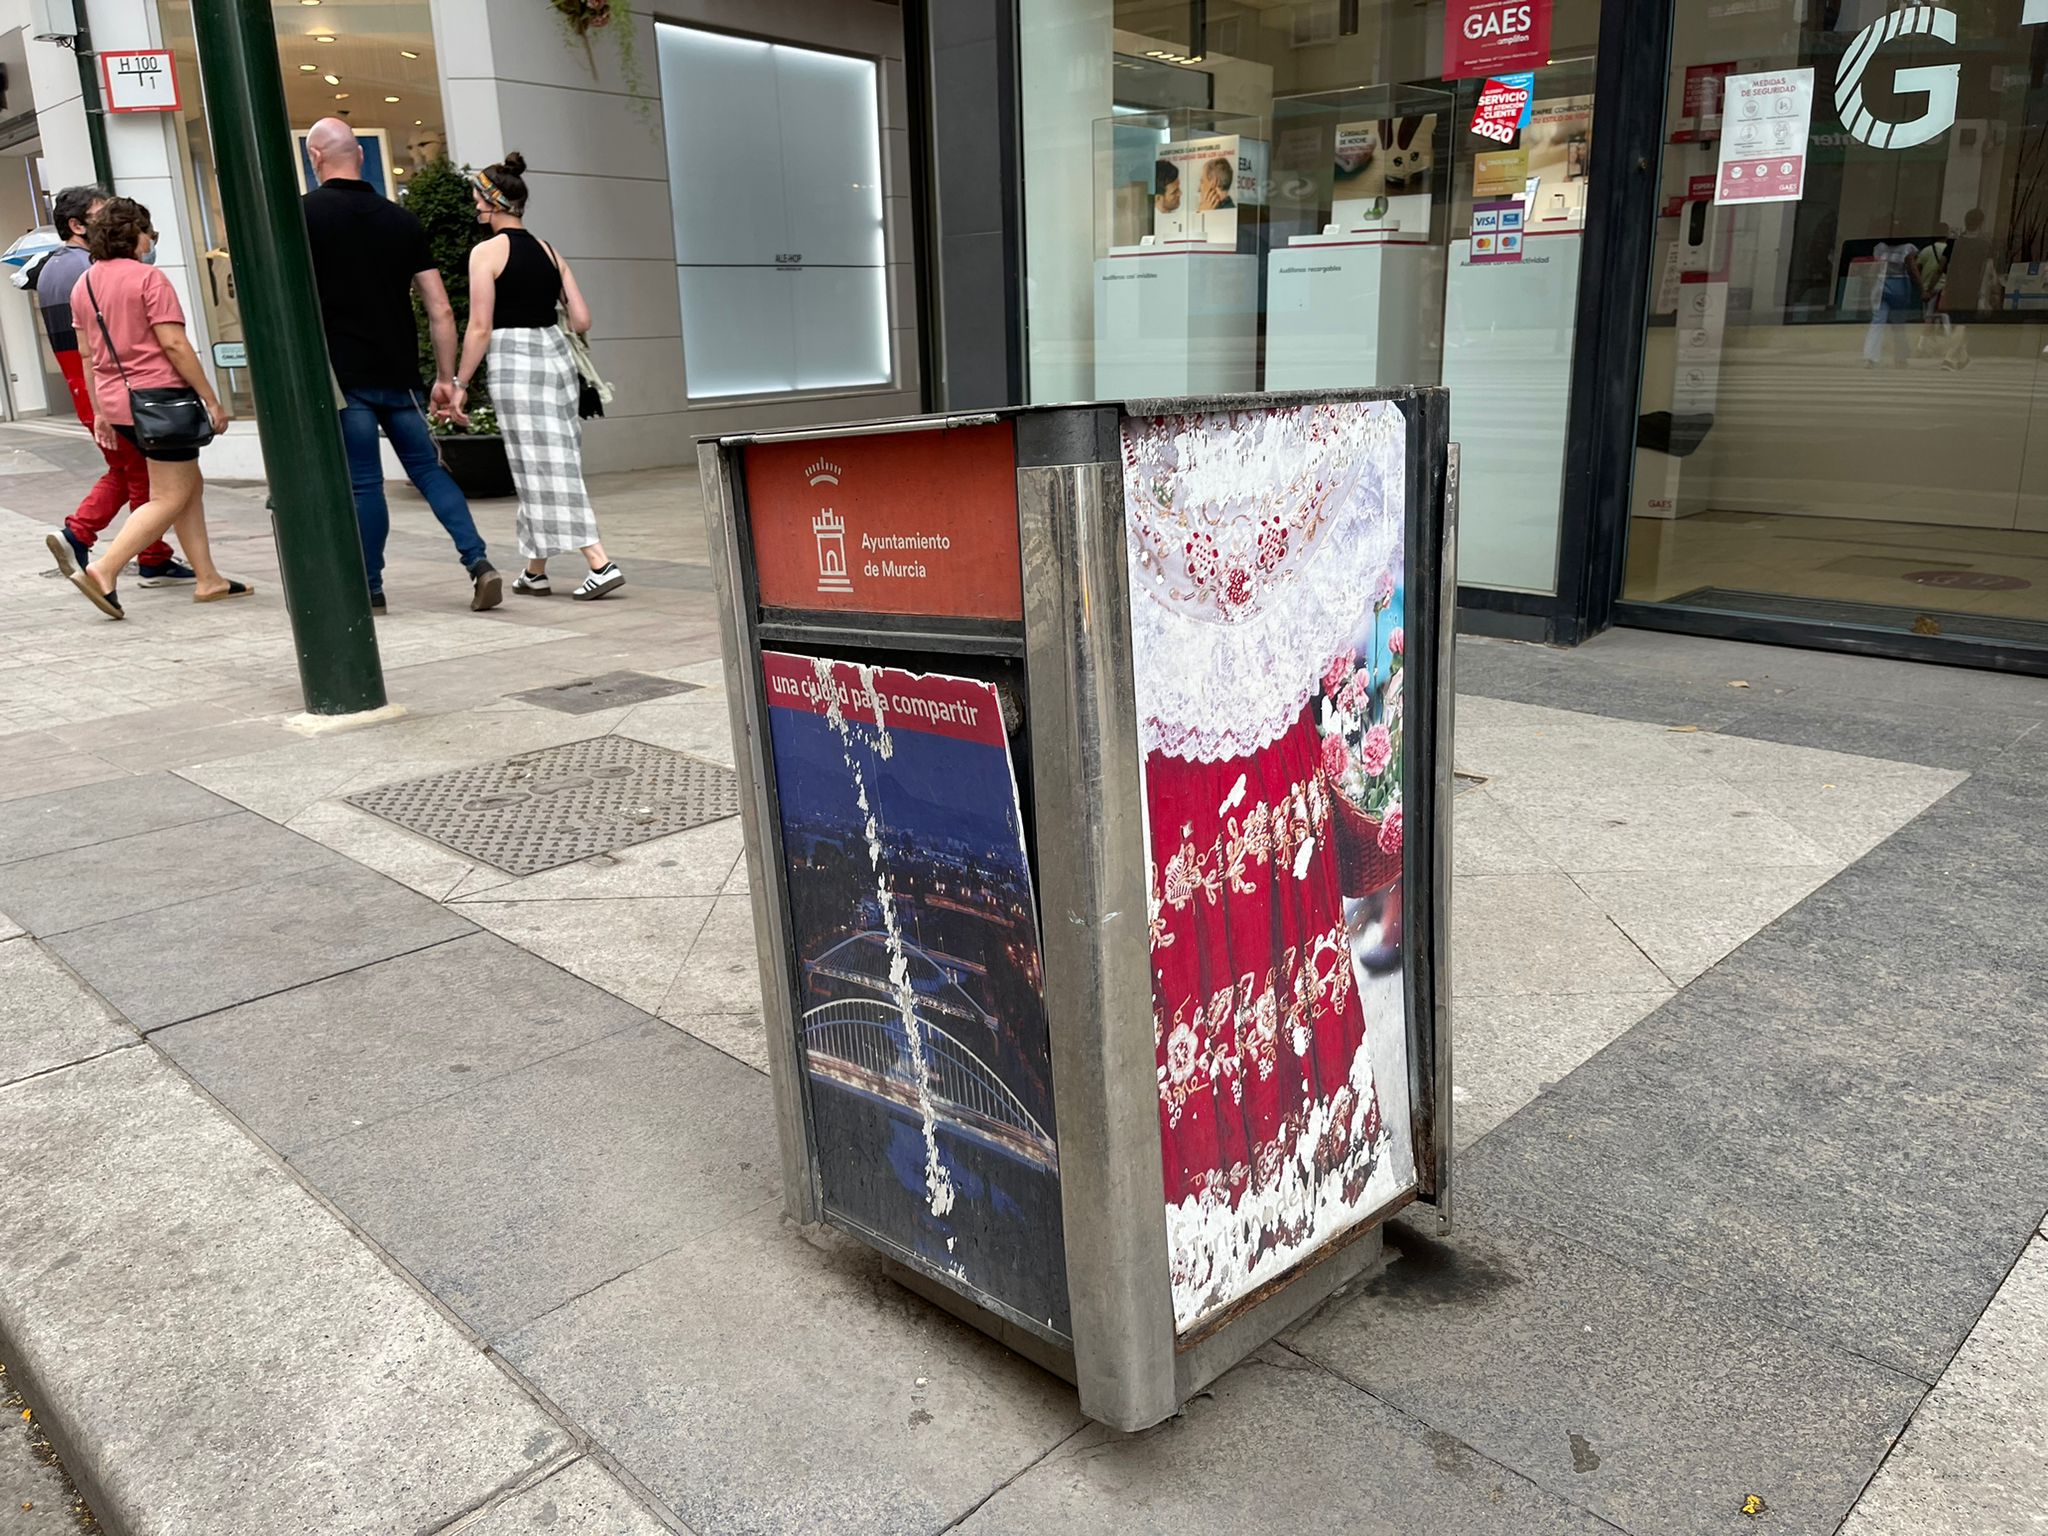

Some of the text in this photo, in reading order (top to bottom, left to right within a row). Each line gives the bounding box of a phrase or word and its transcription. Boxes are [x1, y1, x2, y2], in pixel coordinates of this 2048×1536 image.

[1463, 5, 1531, 39] GAES
[119, 56, 158, 71] H 100
[149, 75, 156, 90] 1
[1752, 77, 1786, 87] MEDIDAS
[1477, 90, 1528, 106] SERVICIO
[1741, 85, 1796, 97] DE SEGURIDAD
[1483, 109, 1517, 119] CLIENTE
[1471, 118, 1513, 143] 2020
[1238, 157, 1252, 172] EBA
[1779, 183, 1797, 191] GAES
[1475, 216, 1496, 226] VISA
[1648, 499, 1672, 508] GAES
[861, 532, 950, 553] Ayuntamiento
[864, 560, 927, 578] de Murcia
[772, 675, 979, 726] una ciudd paa compartir
